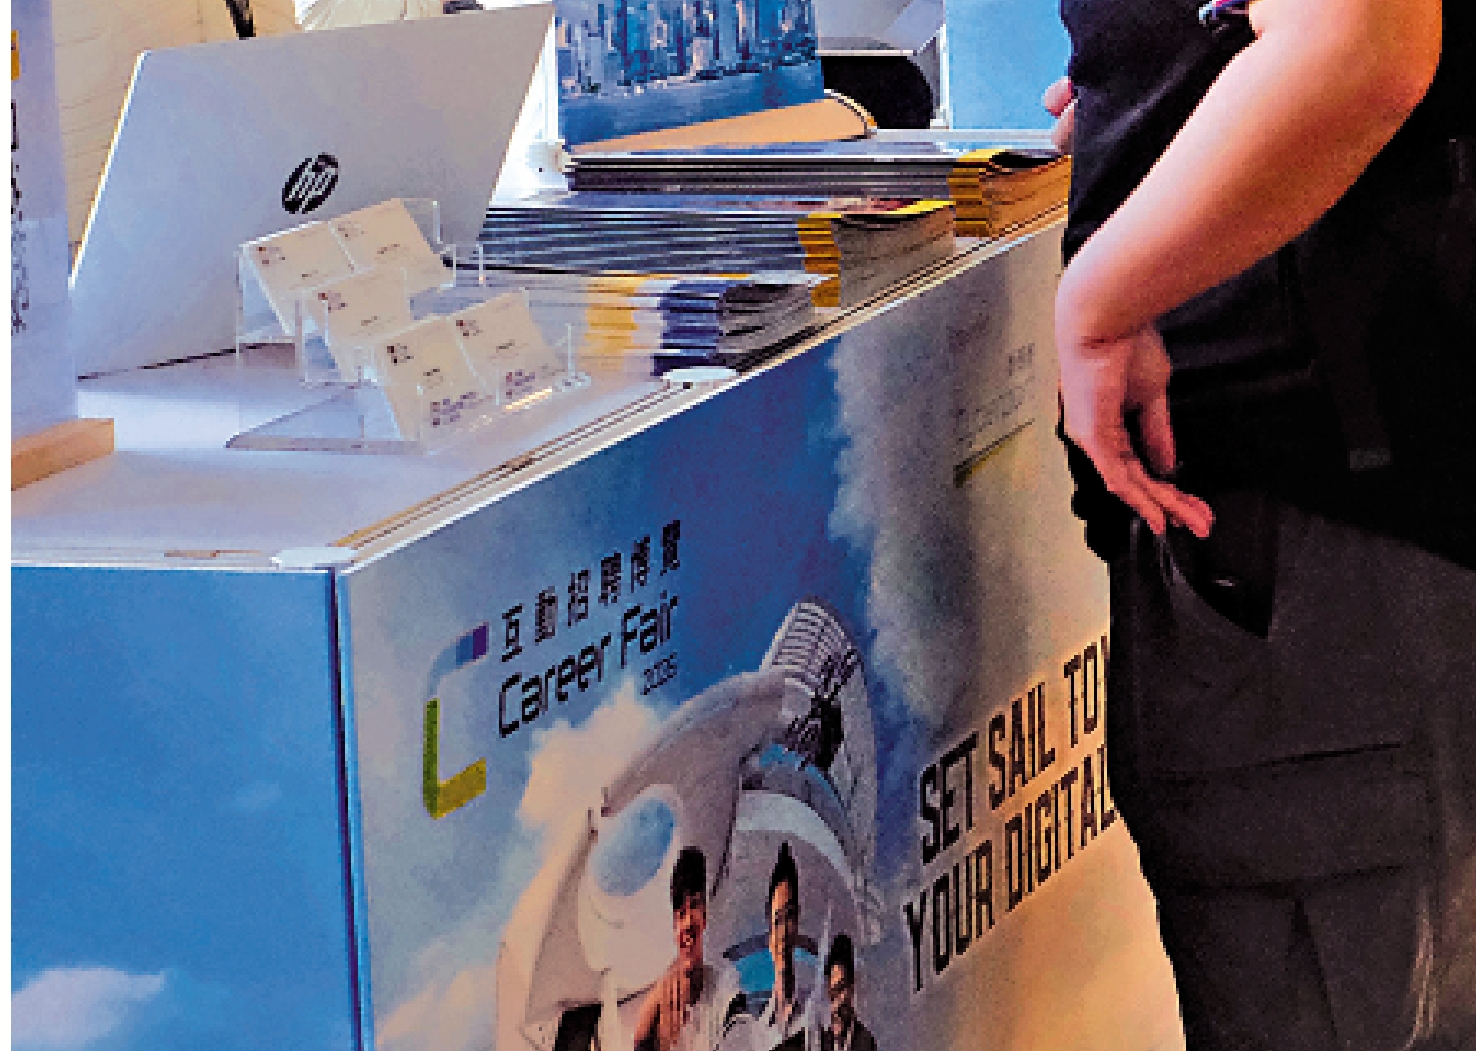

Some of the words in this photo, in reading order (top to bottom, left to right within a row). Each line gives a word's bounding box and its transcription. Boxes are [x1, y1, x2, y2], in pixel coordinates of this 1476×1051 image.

[499, 633, 612, 738] Career
[620, 590, 679, 669] Fair
[920, 731, 979, 866] SET
[988, 682, 1056, 810] SAIL
[903, 840, 996, 993] YOUR
[1004, 744, 1116, 913] DIGITAL
